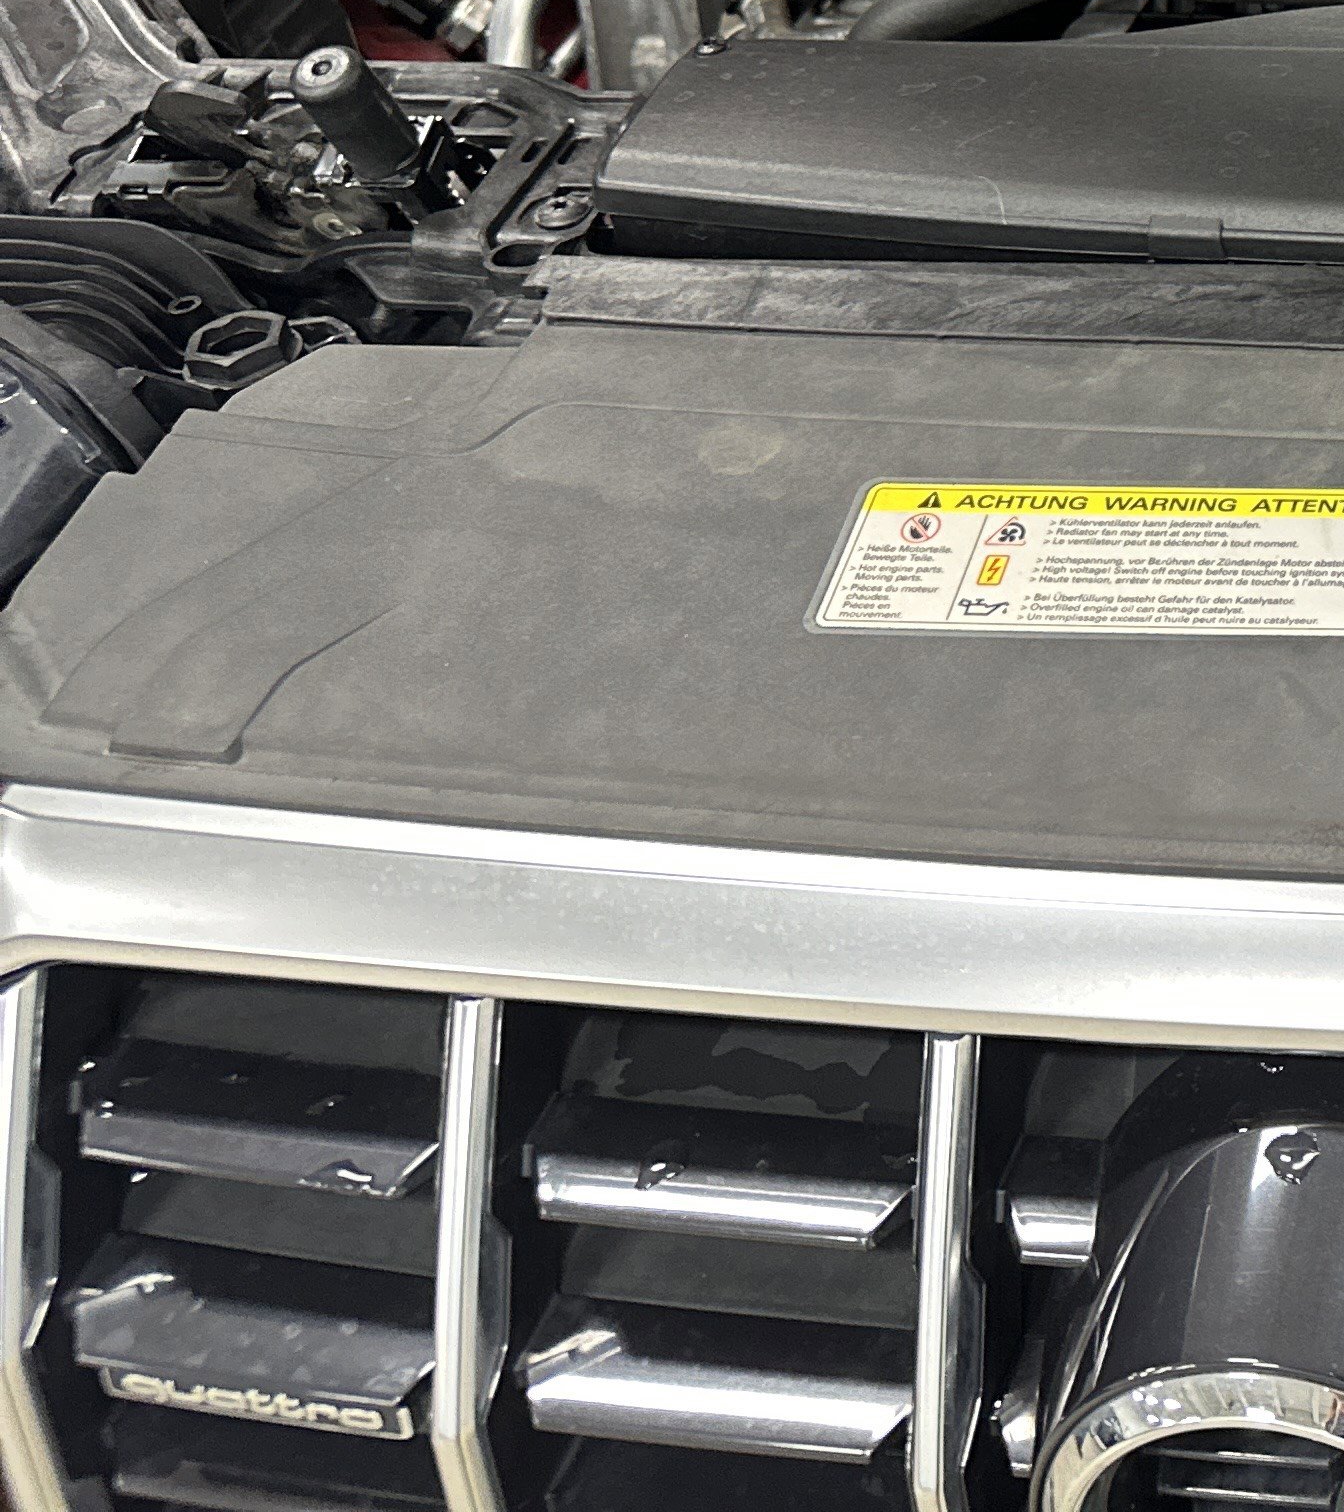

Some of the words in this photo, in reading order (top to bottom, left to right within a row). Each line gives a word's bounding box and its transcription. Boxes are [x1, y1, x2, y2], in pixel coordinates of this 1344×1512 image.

[955, 494, 1088, 510] ACHTUNG
[1105, 496, 1237, 512] WARNING
[1059, 518, 1140, 527] Kühlerventilator
[1141, 519, 1168, 528] kann
[1168, 519, 1213, 529] jederzeit
[1214, 520, 1261, 529] anlaufen.
[1055, 526, 1099, 536] Radiator
[1100, 527, 1118, 537] fan
[1119, 529, 1143, 538] may
[1144, 529, 1169, 537] start
[1168, 529, 1181, 538] at
[1181, 530, 1202, 539] any
[1203, 530, 1229, 538] time.
[1051, 537, 1065, 545] Le
[1067, 537, 1122, 546] ventilateur
[1122, 538, 1148, 547] peut
[1148, 539, 1162, 547] se
[1229, 539, 1252, 548] tout
[1252, 540, 1299, 548] moment.
[1196, 557, 1216, 566] der
[1216, 557, 1278, 568] Zündanlage
[1279, 558, 1313, 567] Motor
[1042, 565, 1067, 575] High
[1113, 565, 1149, 575] Switch
[1150, 566, 1167, 575] off
[1167, 567, 1203, 577] engine
[1205, 567, 1239, 576] before
[1240, 567, 1287, 578] touching
[1288, 568, 1329, 579] ignition
[1038, 574, 1070, 583] Haute
[1114, 576, 1151, 585] arrêter
[1151, 576, 1163, 585] le
[1163, 577, 1202, 585] moteur
[1203, 578, 1234, 586] avant
[1234, 577, 1249, 586] de
[1250, 576, 1291, 587] toucher
[1033, 592, 1051, 602] Bei
[1116, 594, 1156, 603] besteht
[1157, 594, 1194, 604] Gefahr
[1195, 595, 1211, 604] für
[1212, 595, 1233, 605] den
[1029, 602, 1081, 612] Overfilled
[1082, 605, 1119, 614] engine
[1120, 604, 1135, 613] oil
[1135, 606, 1155, 614] can
[1156, 605, 1200, 615] damage
[1026, 612, 1043, 621] Un
[1044, 613, 1108, 624] remplissage
[1109, 614, 1153, 623] excessif
[1191, 616, 1217, 625] peut
[1218, 616, 1246, 624] nuire
[1247, 616, 1262, 625] au
[120, 1373, 384, 1431] quattro
